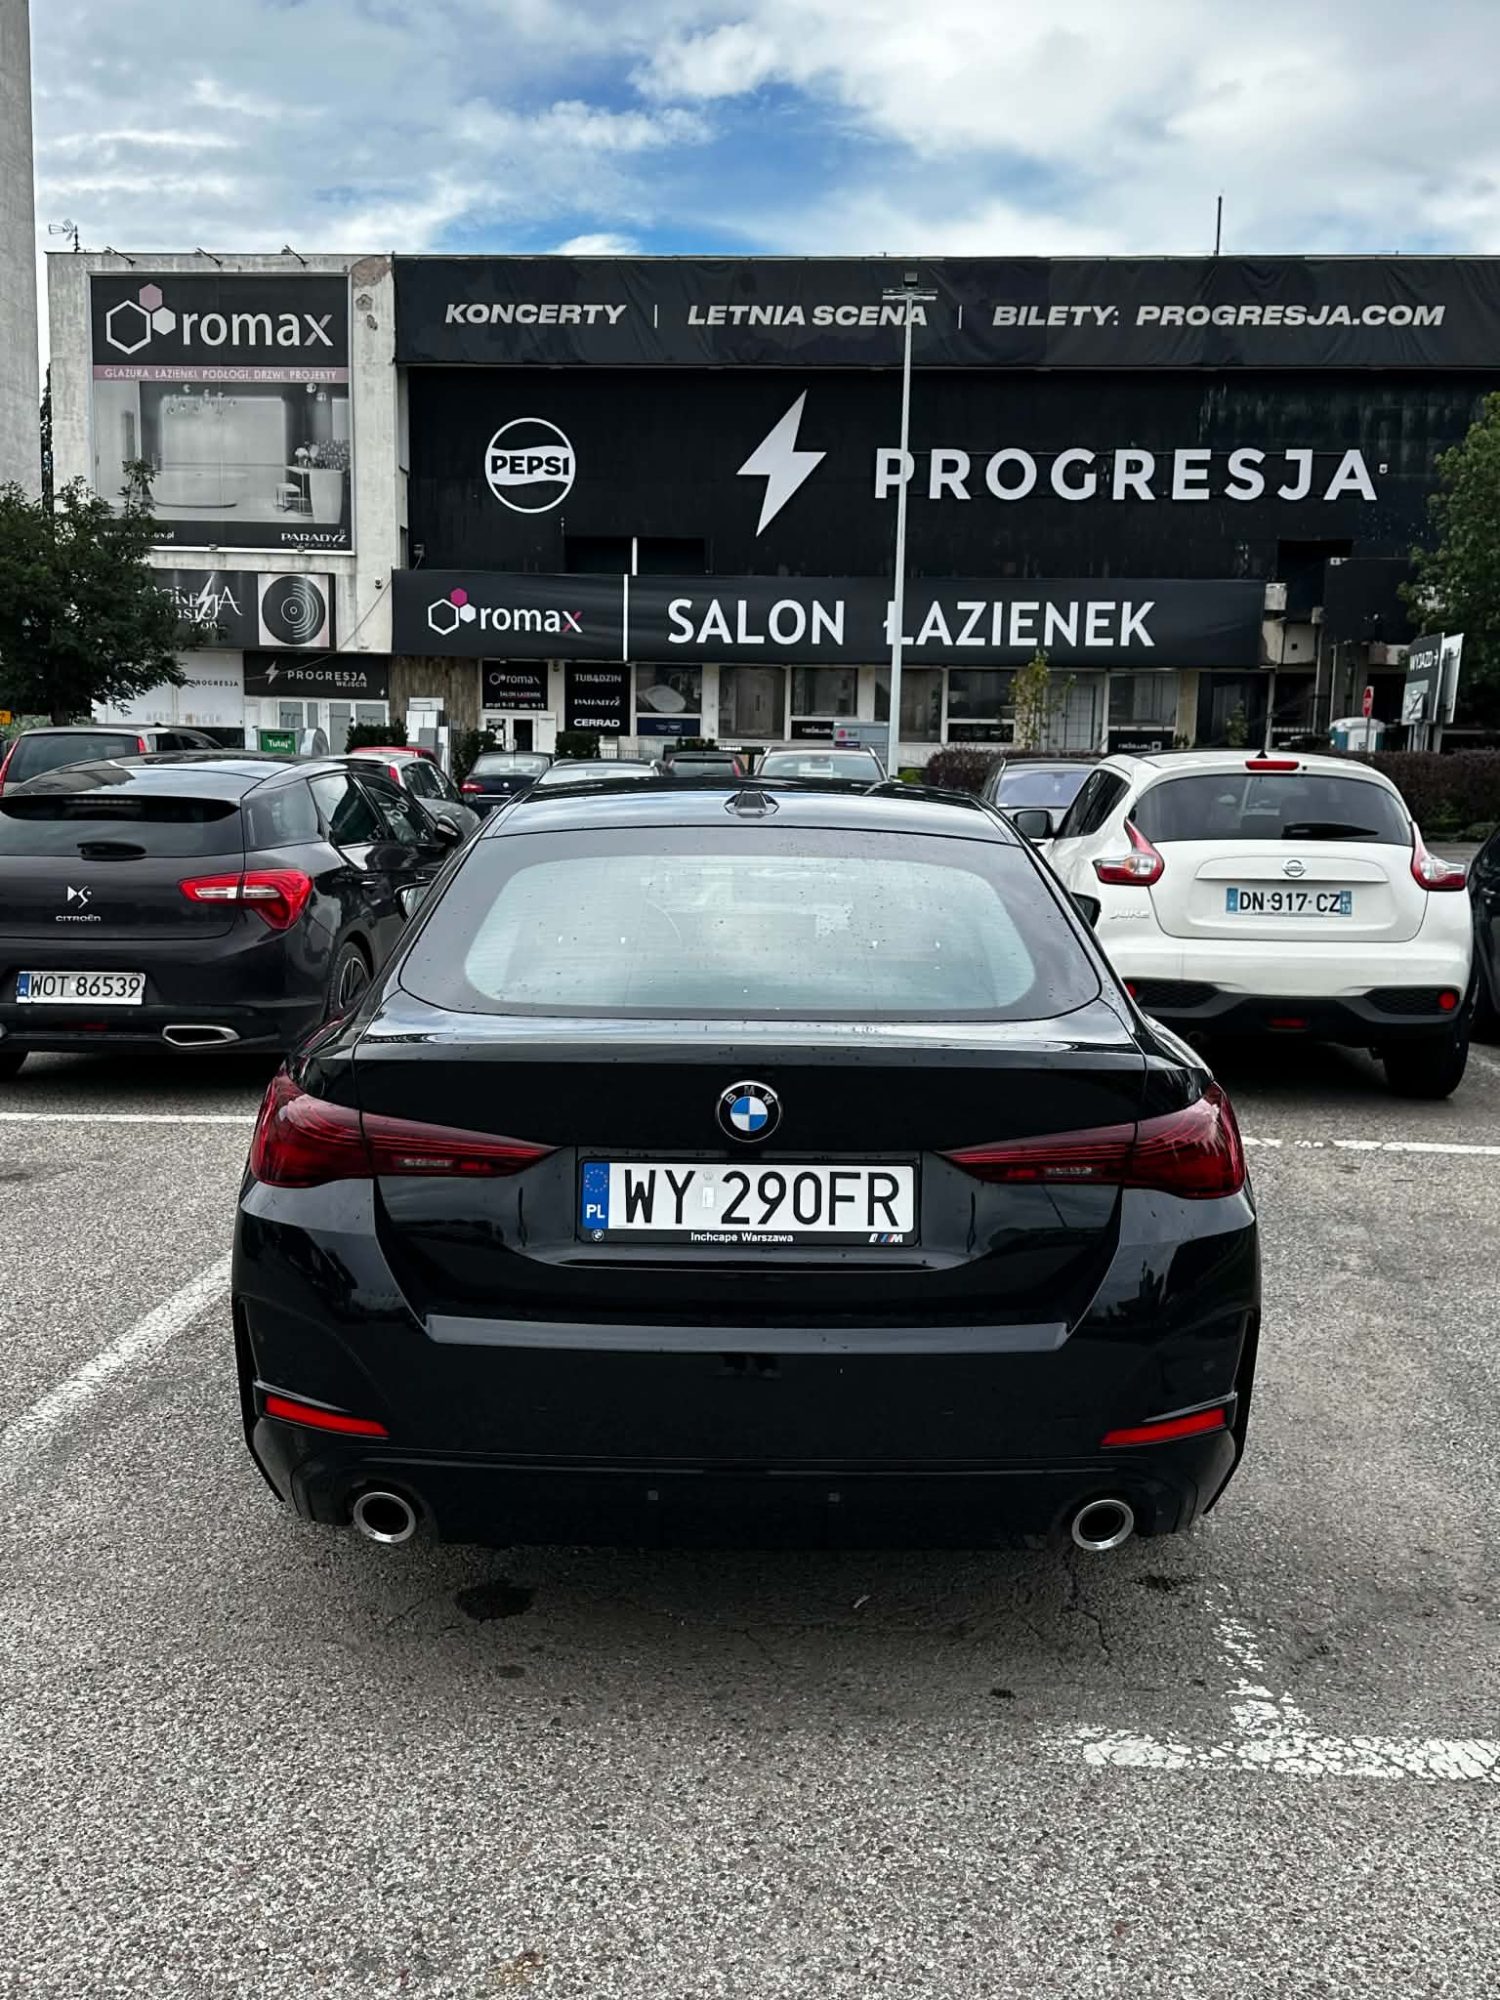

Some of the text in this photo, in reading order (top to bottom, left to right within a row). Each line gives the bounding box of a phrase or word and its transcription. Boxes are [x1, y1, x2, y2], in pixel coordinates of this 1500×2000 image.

[445, 304, 626, 324] KONCERTY
[688, 305, 928, 326] LETNIA SCENA
[992, 305, 1446, 326] BILETY: PROGRESJA.COM
[182, 312, 334, 347] romax
[491, 455, 570, 476] PEPSI
[875, 448, 1378, 501] PROGRESJA
[480, 606, 583, 633] romax
[668, 599, 1155, 648] SALON ŁAZIENEK
[287, 669, 367, 681] PROGRESJA
[573, 718, 620, 727] CERRAD
[31, 975, 140, 998] WOT 86539
[624, 1169, 900, 1227] WY 290FR
[586, 1203, 606, 1219] PL
[690, 1231, 794, 1243] Inchcape Warszawa
